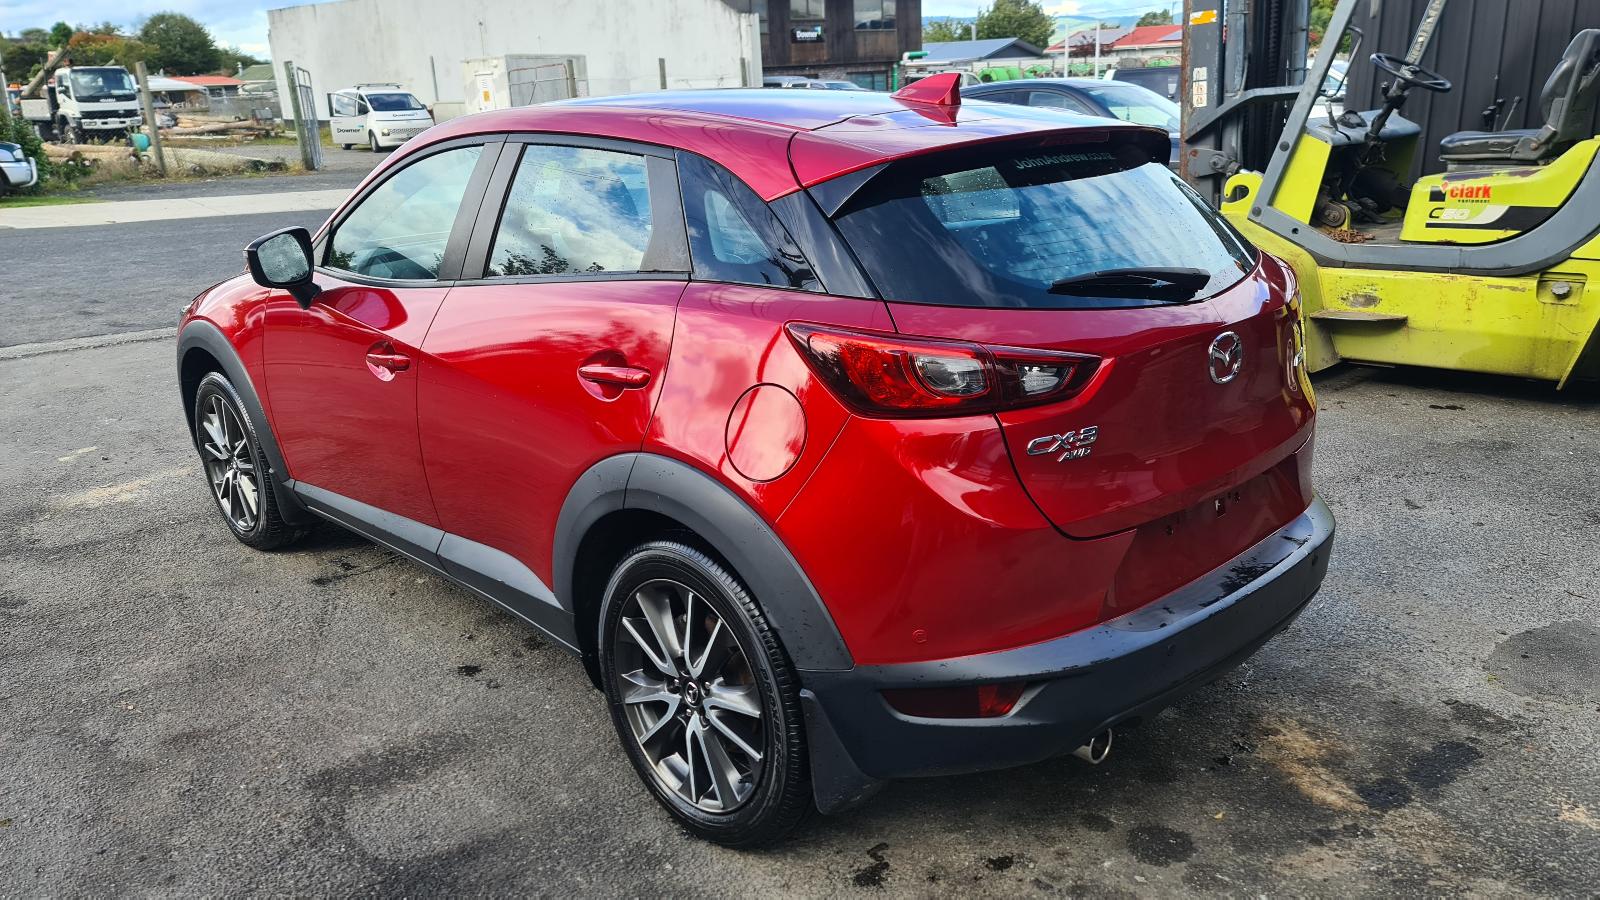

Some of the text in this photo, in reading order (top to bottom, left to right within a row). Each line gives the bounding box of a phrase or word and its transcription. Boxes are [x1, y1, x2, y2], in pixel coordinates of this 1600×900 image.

[1449, 184, 1491, 199] clark
[1027, 425, 1098, 456] CX-3
[1057, 446, 1092, 463] AWD
